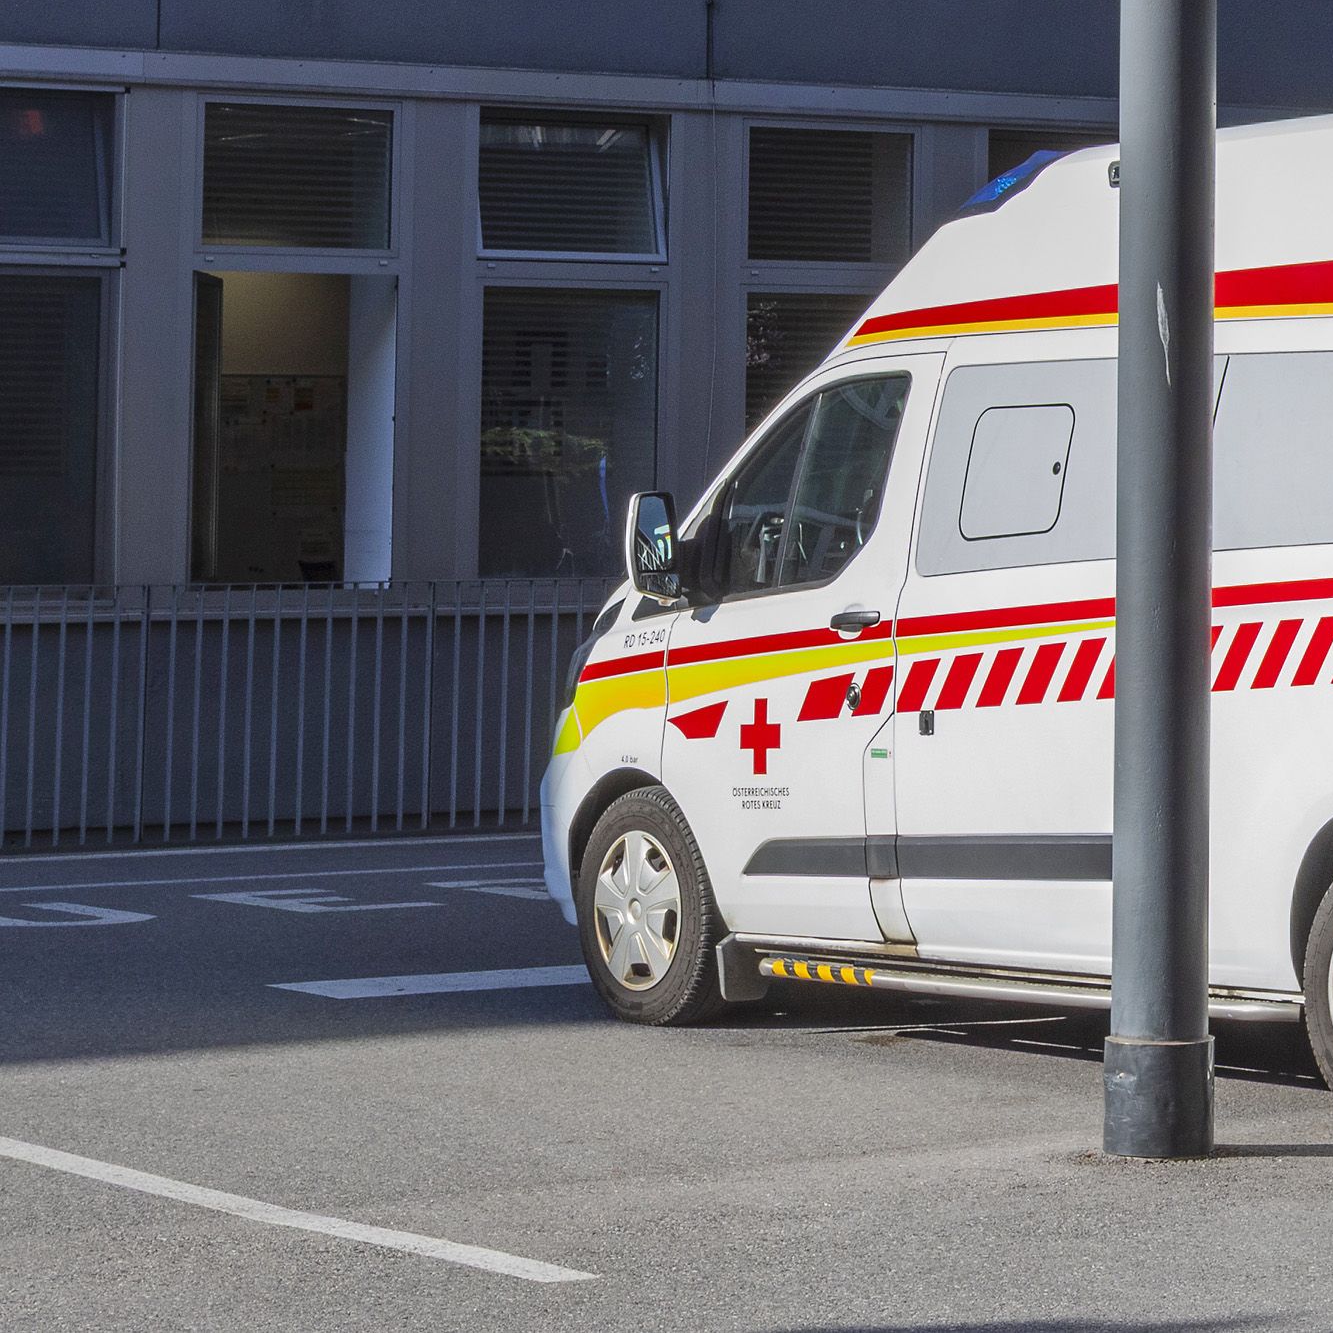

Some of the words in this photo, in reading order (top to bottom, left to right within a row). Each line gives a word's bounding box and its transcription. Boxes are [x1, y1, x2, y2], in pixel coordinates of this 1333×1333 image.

[624, 634, 636, 648] RD
[638, 629, 666, 645] 15-240
[732, 786, 790, 798] ÖSTERREICHISCHES
[741, 799, 761, 810] ROTES
[762, 799, 781, 810] KREUZ
